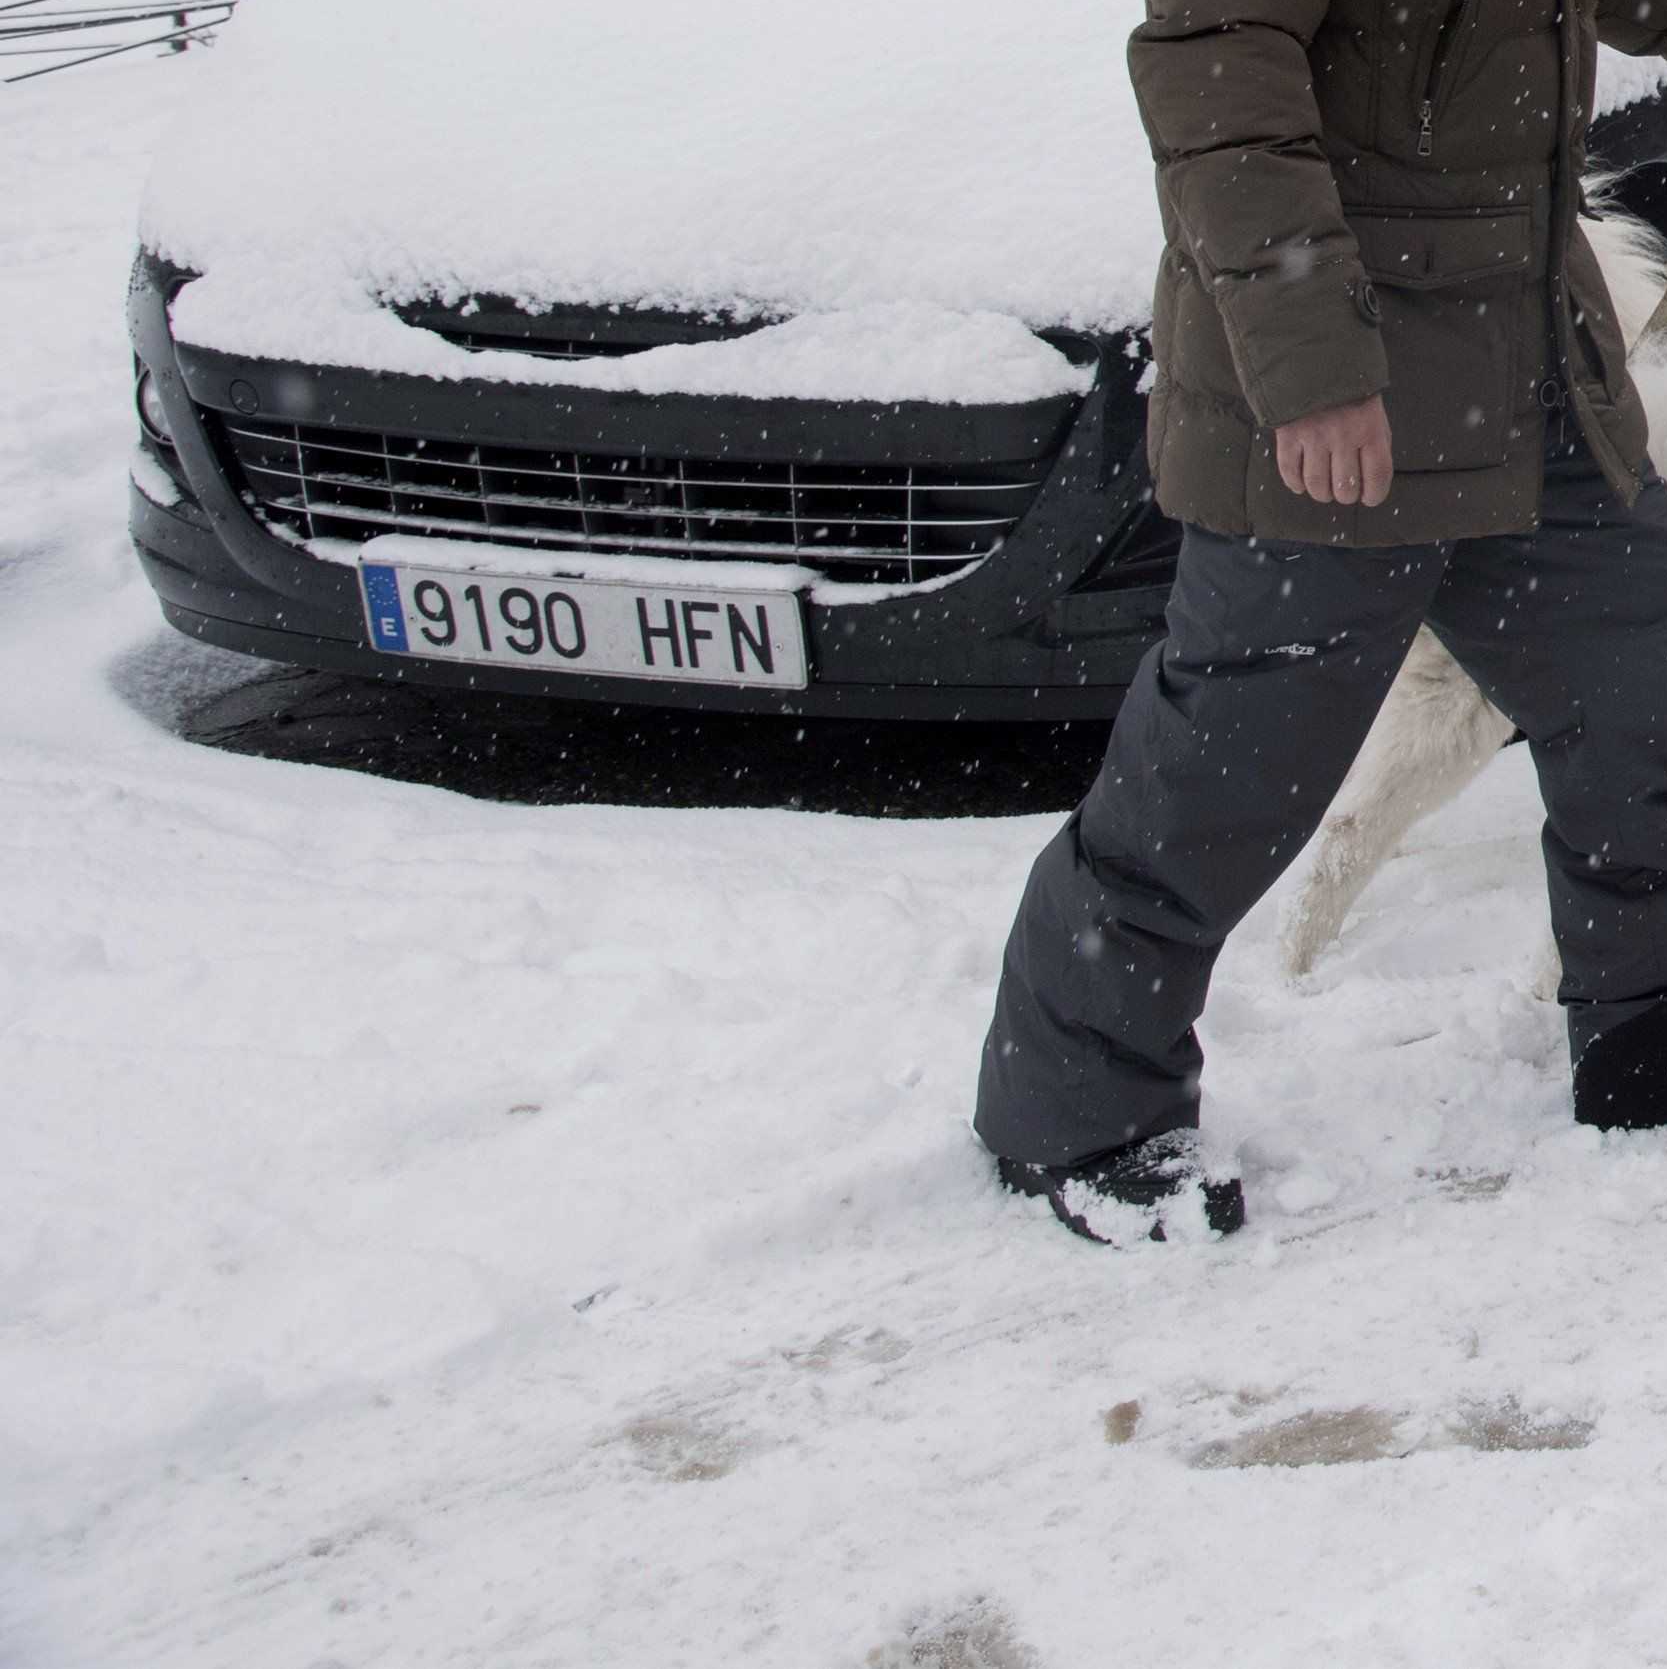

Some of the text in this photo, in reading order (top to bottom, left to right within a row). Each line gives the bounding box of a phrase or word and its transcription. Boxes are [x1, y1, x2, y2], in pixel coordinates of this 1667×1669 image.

[381, 617, 398, 637] E
[414, 579, 774, 674] 9190 HFN
